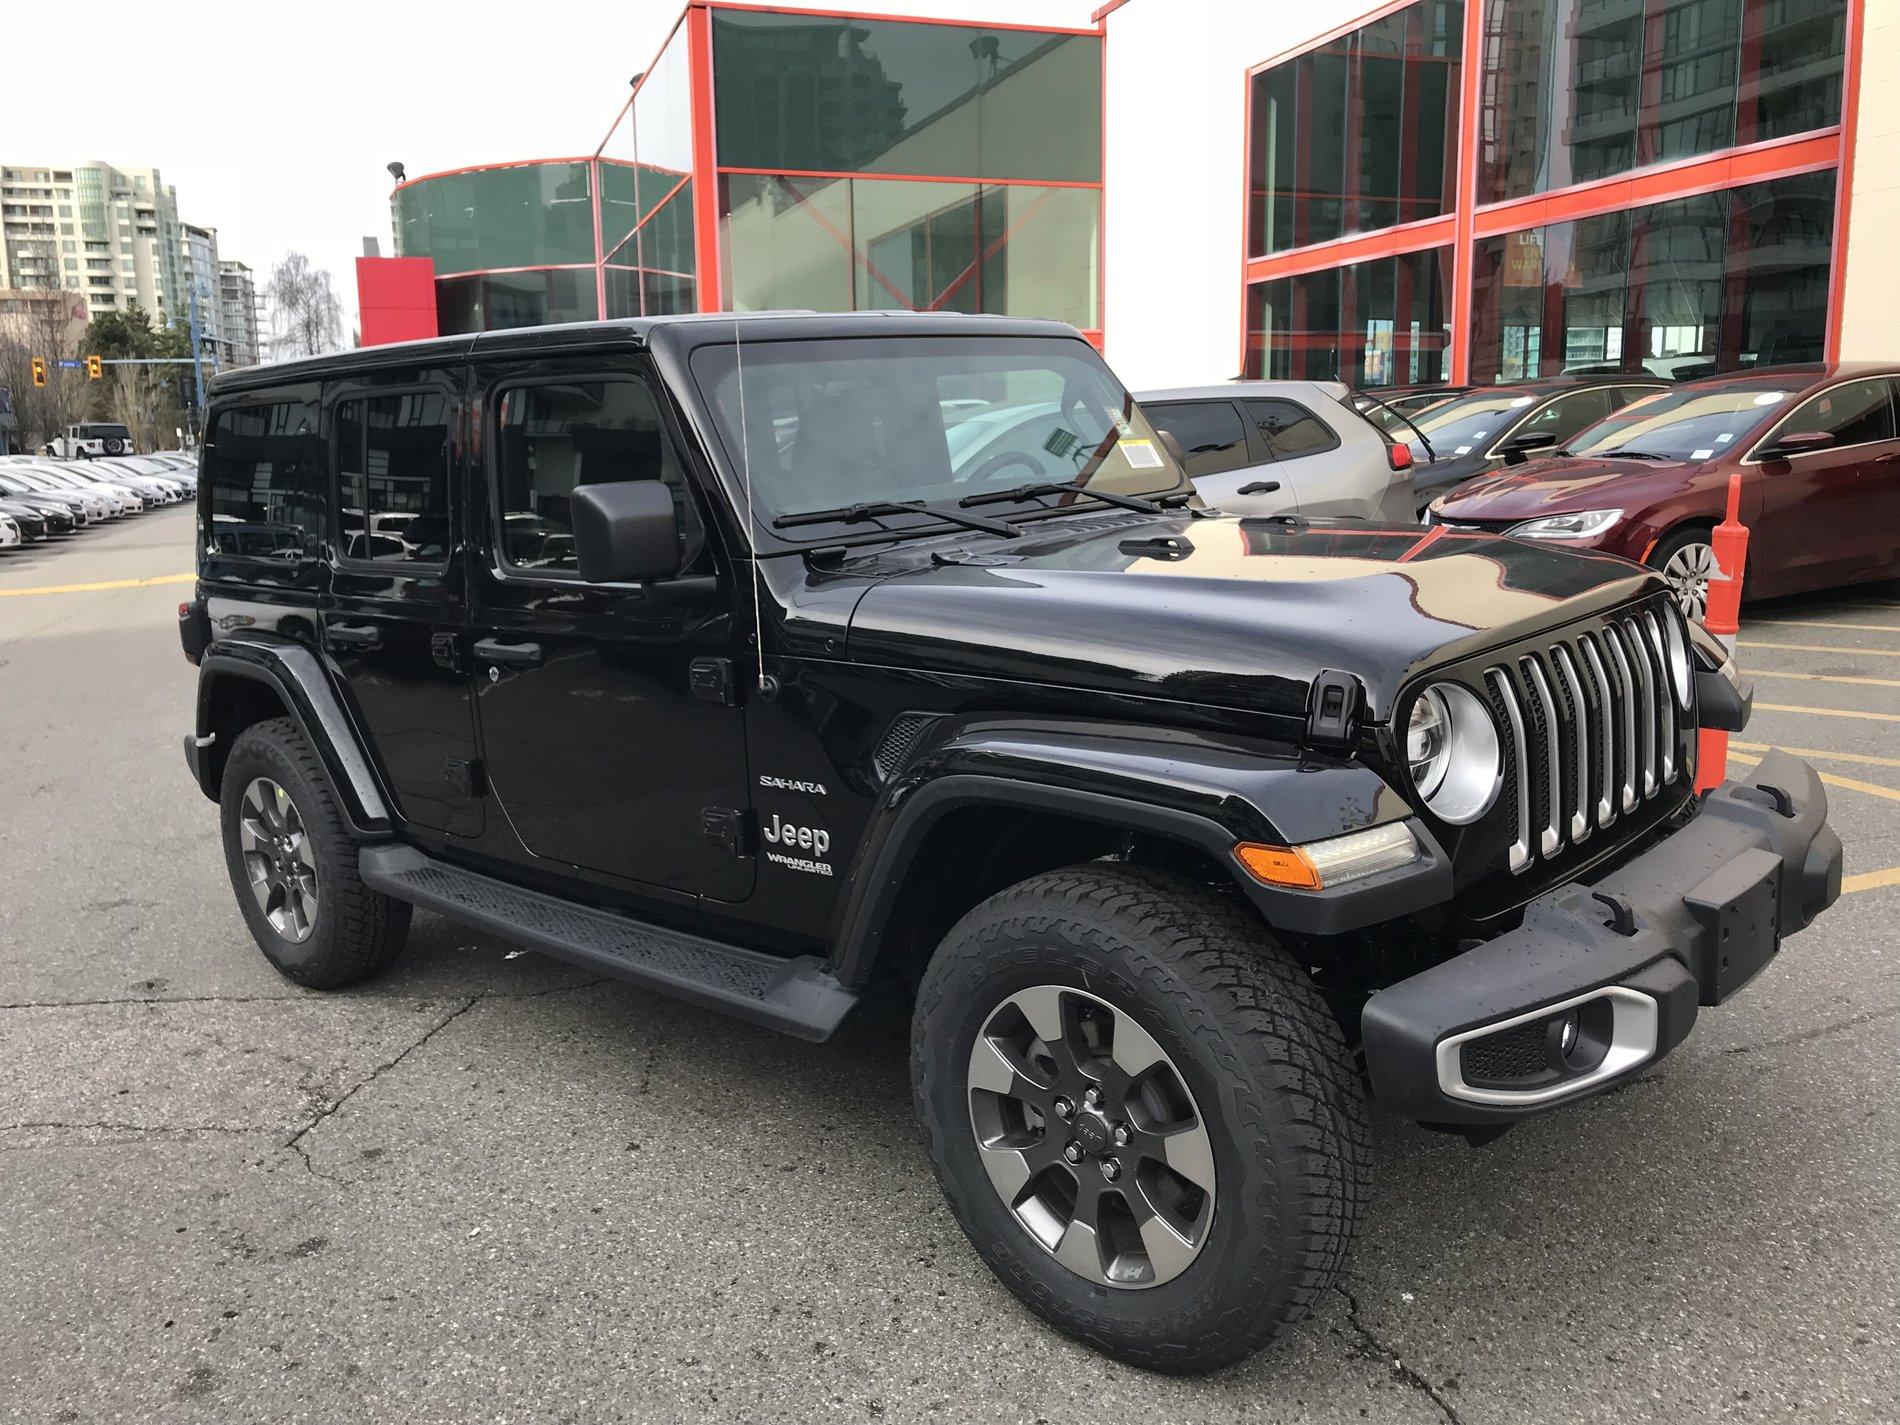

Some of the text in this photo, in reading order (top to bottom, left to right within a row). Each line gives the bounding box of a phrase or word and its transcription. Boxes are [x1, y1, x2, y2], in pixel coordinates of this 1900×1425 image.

[759, 775, 828, 795] SAHARA
[763, 814, 831, 857] Jeep
[766, 852, 832, 871] WRANGLER
[787, 864, 834, 876] UNLIMITED
